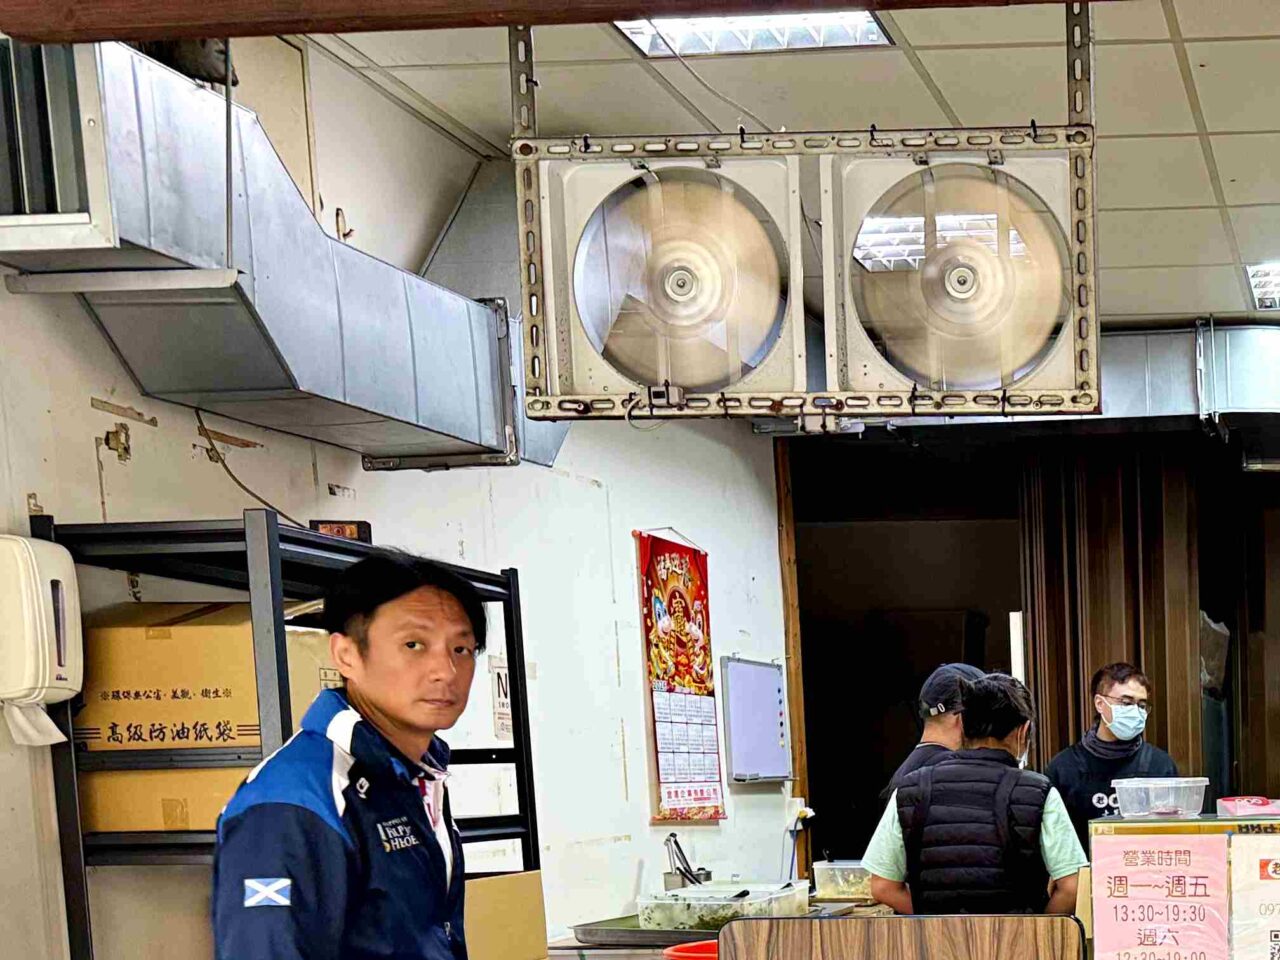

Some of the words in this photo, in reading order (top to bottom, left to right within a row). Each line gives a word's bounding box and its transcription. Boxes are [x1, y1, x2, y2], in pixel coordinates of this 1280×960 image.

[107, 719, 237, 744] 高級防油紙袋
[1123, 850, 1192, 867] 營業時間
[1107, 875, 1211, 898] 週一~週五
[1113, 904, 1206, 922] 13:30~19:30
[1137, 928, 1180, 946] 週六
